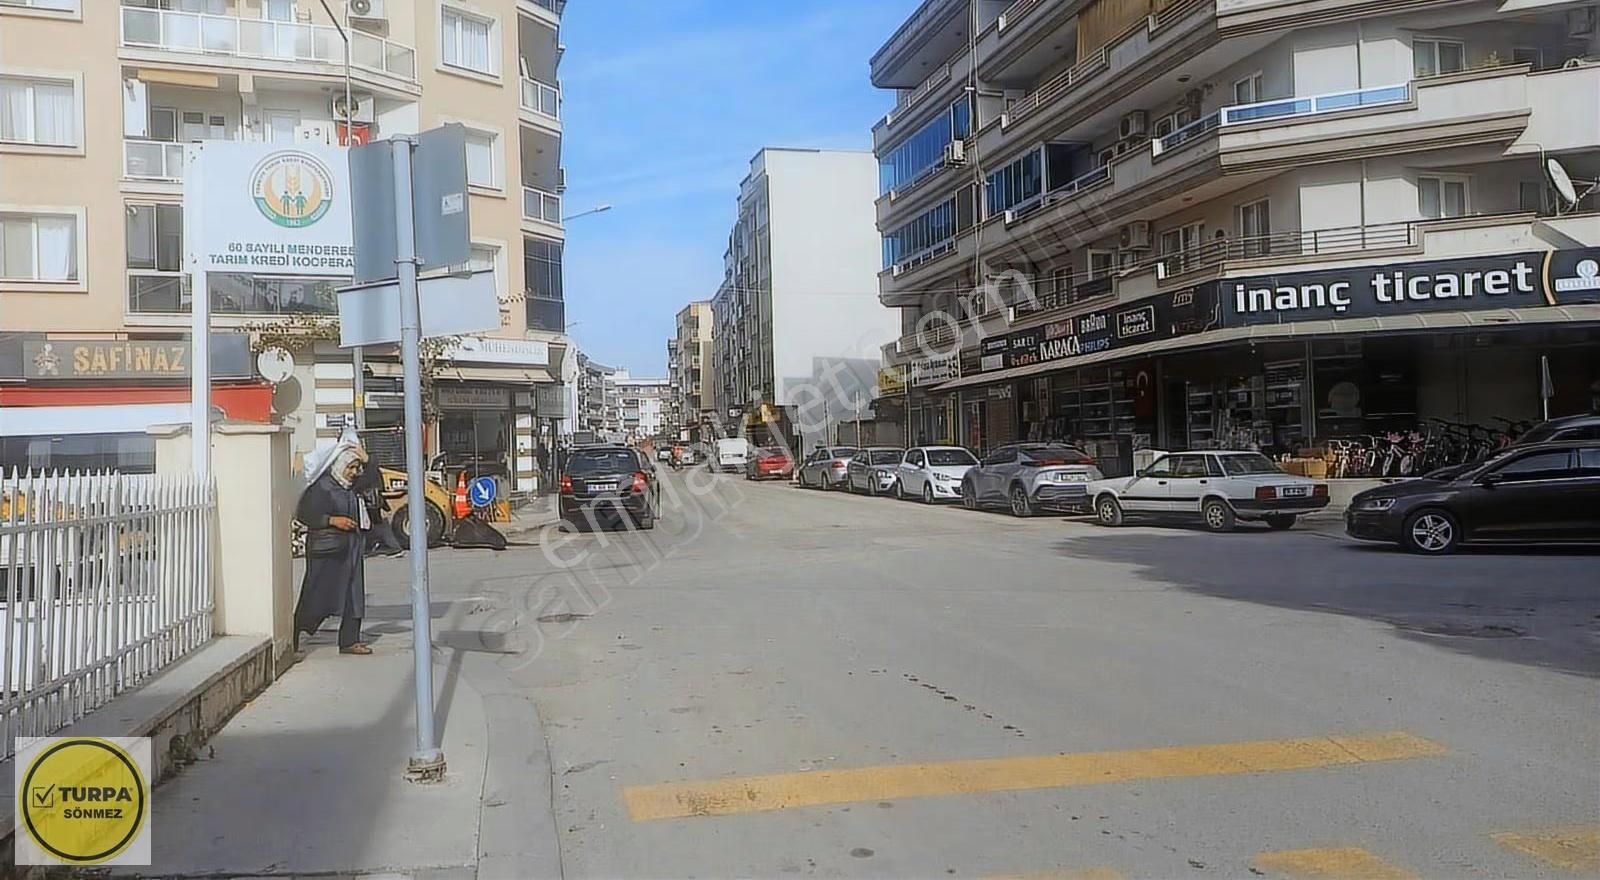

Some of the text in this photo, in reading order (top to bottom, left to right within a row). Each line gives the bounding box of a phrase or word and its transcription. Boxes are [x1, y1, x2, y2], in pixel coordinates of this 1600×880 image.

[209, 254, 248, 264] TARIM
[251, 252, 289, 266] KREDİ
[228, 242, 243, 253] 60
[1235, 284, 1350, 314] inanç
[1371, 262, 1534, 303] ticaret
[73, 343, 186, 372] SAFİNAZ
[1039, 335, 1081, 361] KARACA
